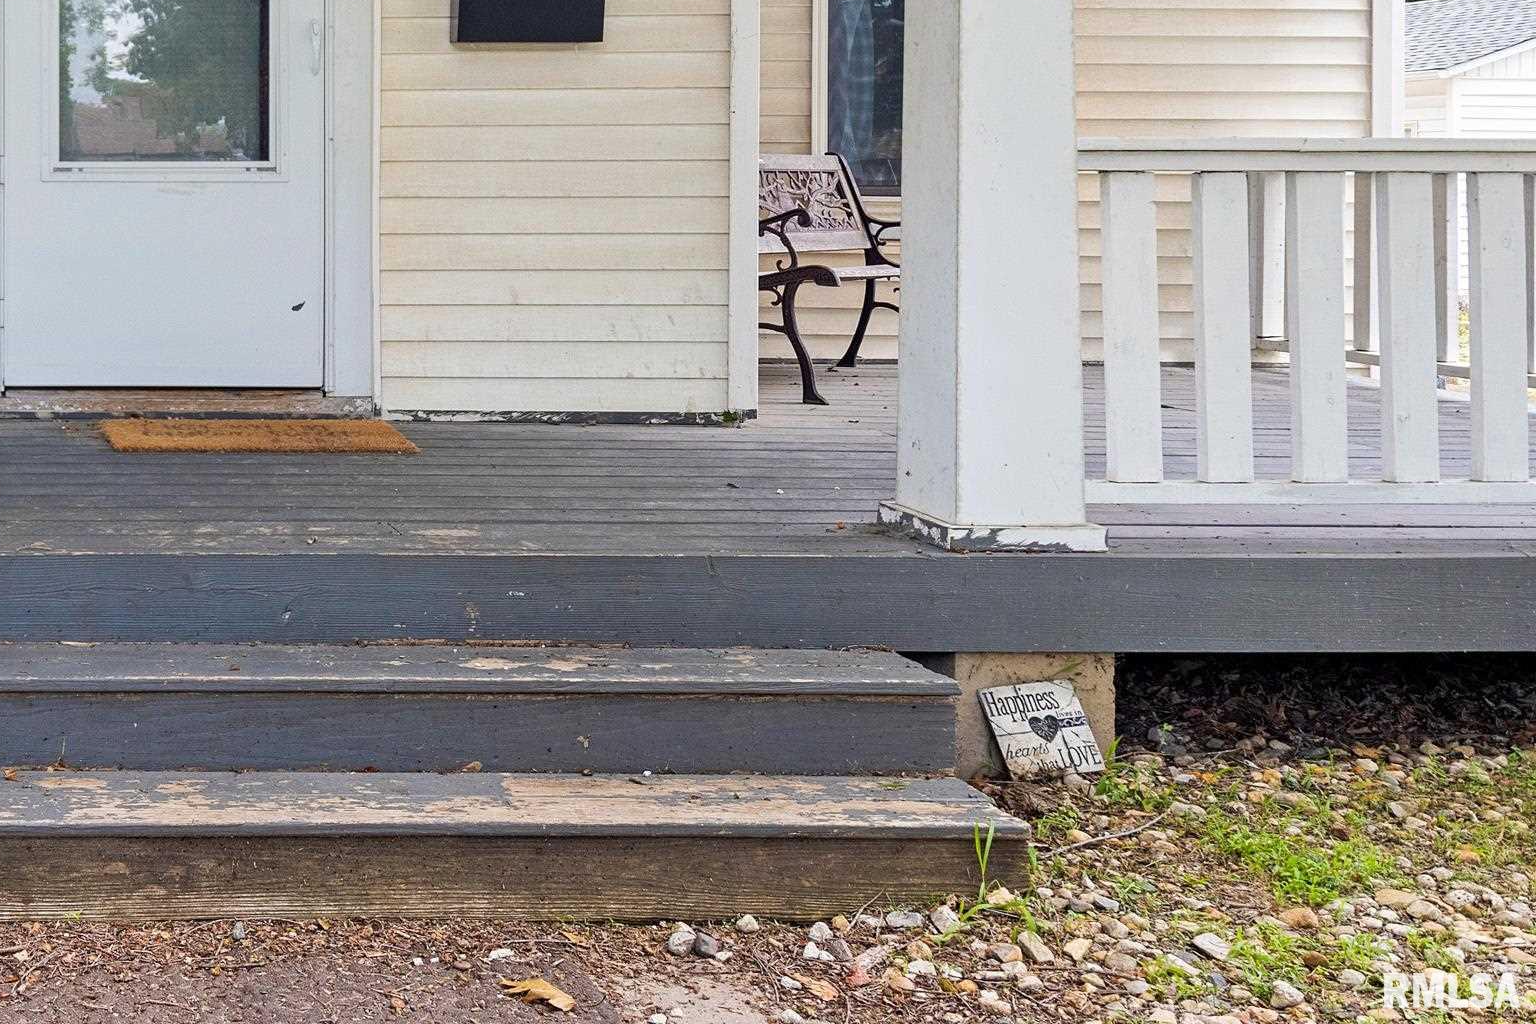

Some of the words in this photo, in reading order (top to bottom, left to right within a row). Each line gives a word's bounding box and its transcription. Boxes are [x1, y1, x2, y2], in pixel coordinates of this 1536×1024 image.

[982, 688, 1061, 722] Happiness
[1006, 742, 1049, 760] hearts
[1057, 745, 1102, 769] LOVE
